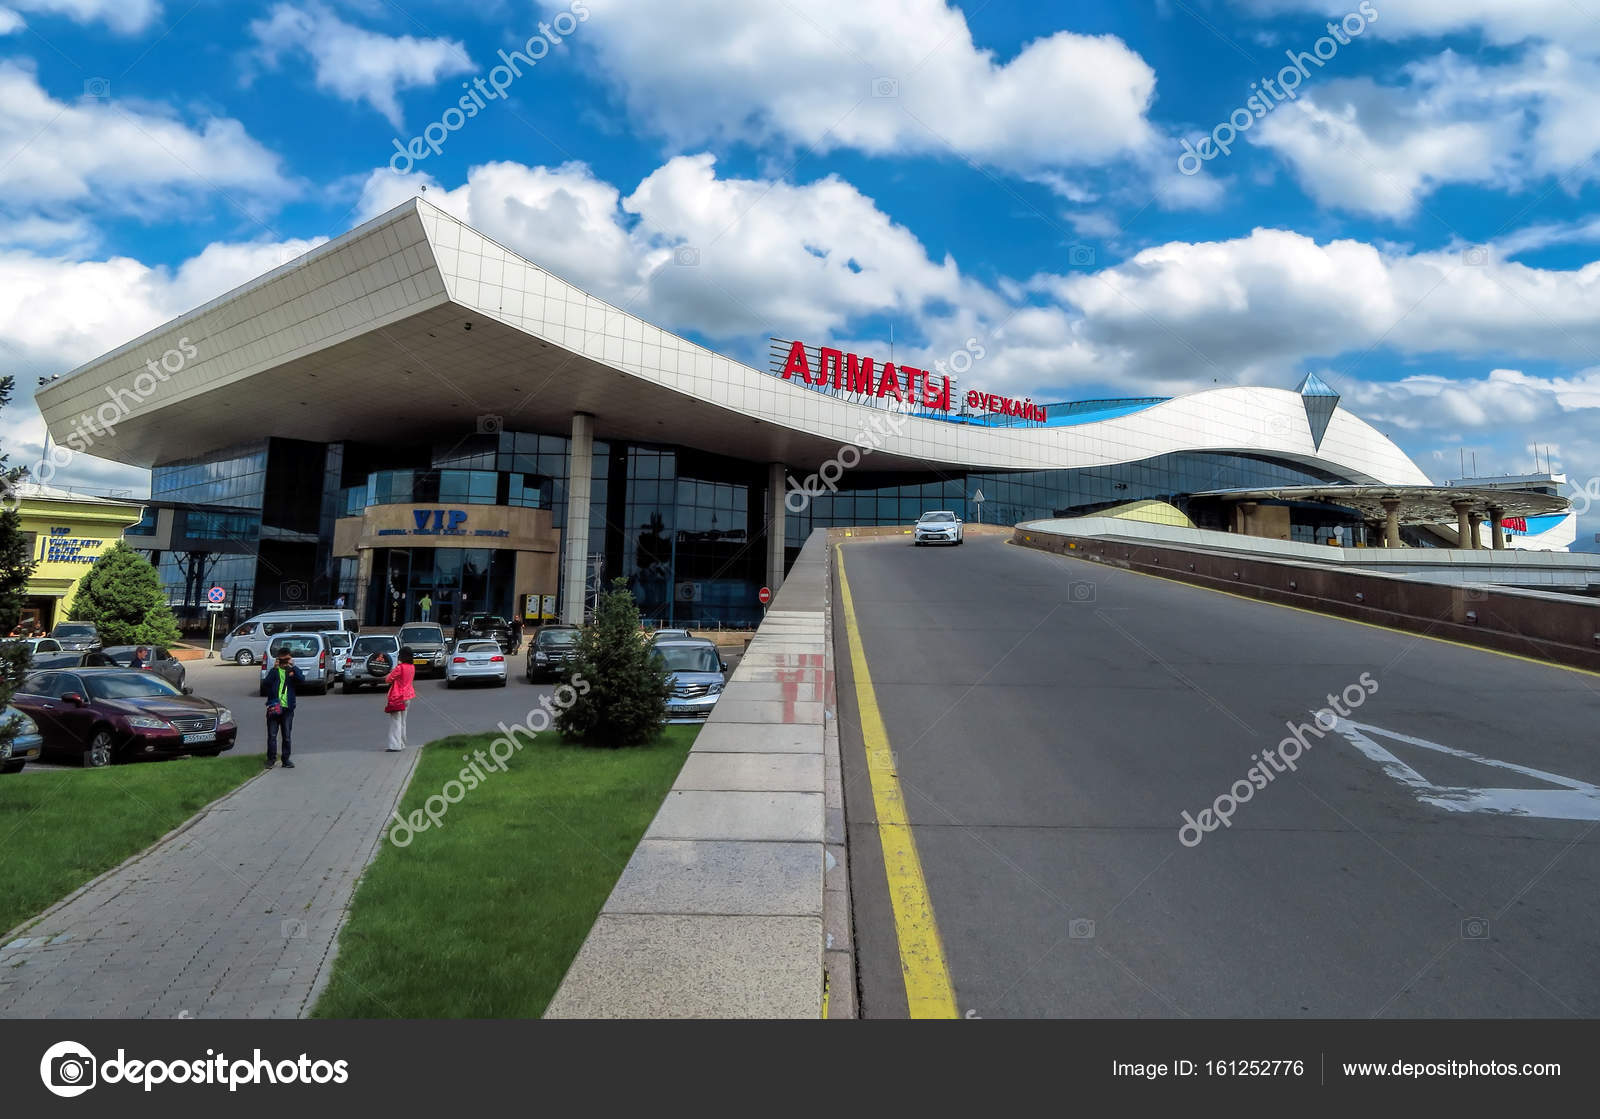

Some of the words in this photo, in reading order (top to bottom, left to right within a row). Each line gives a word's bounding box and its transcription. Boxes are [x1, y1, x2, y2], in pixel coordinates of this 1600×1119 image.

[782, 341, 951, 412] АЛМАТЫ
[967, 389, 1047, 424] ӘУЕЖАЙЫ
[51, 527, 71, 536] VIP
[412, 509, 468, 530] VIP
